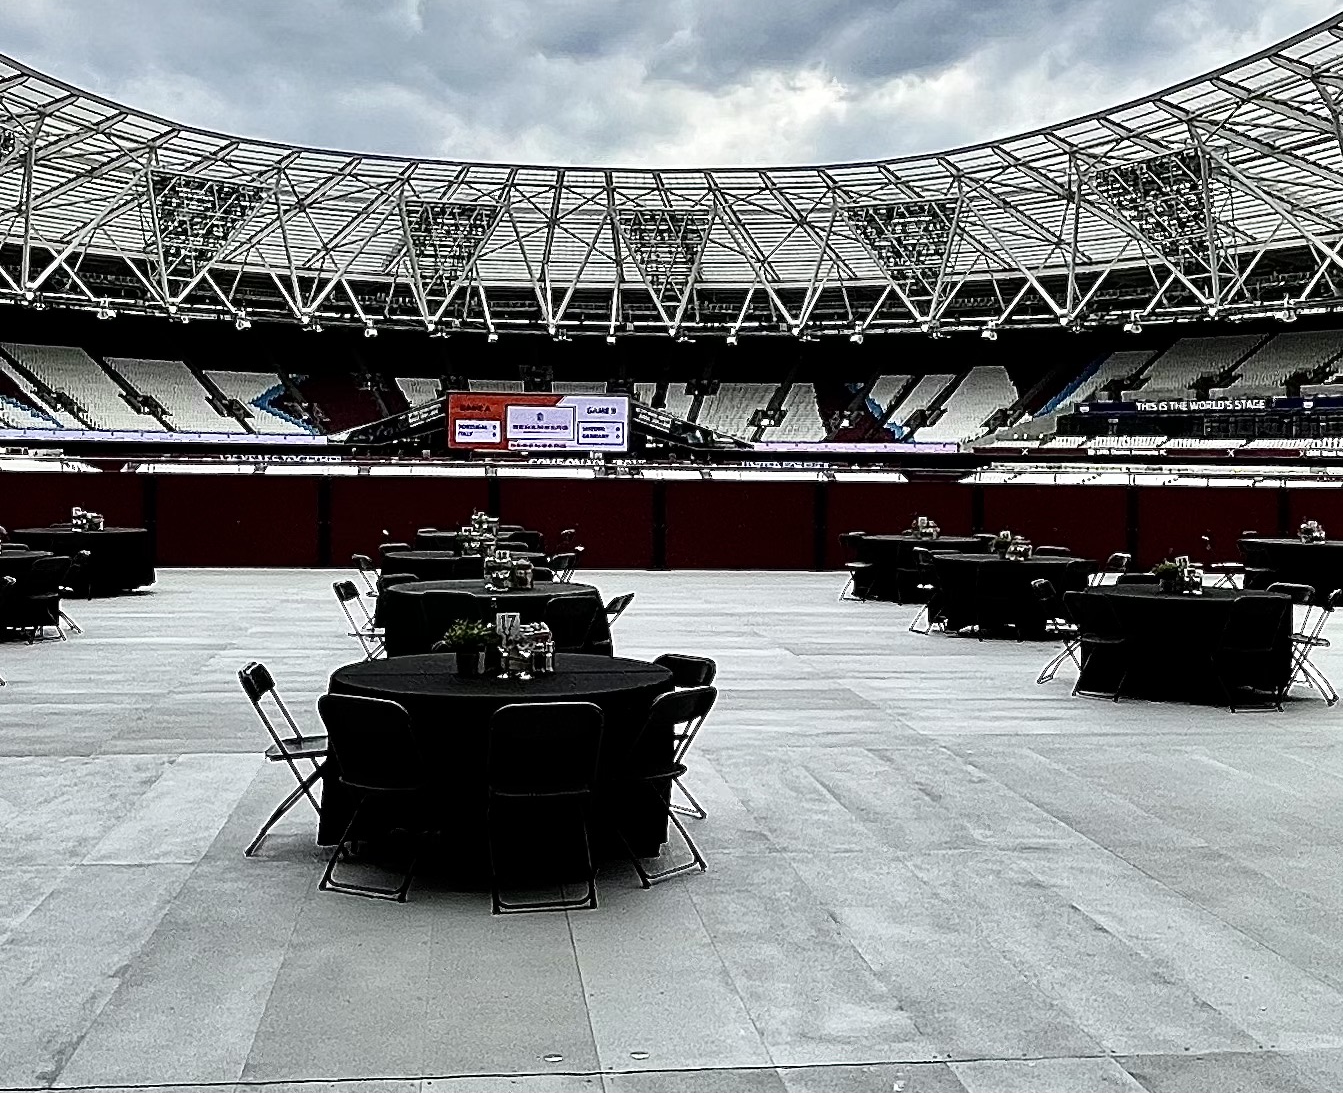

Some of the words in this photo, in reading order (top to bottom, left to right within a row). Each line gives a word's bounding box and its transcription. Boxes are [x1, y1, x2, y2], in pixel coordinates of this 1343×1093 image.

[1136, 401, 1158, 411] THIS
[1159, 401, 1168, 411] IS
[1169, 401, 1188, 410] THE
[1189, 400, 1233, 410] WORLD'S
[1234, 399, 1266, 409] STAGE
[501, 614, 517, 635] 17
